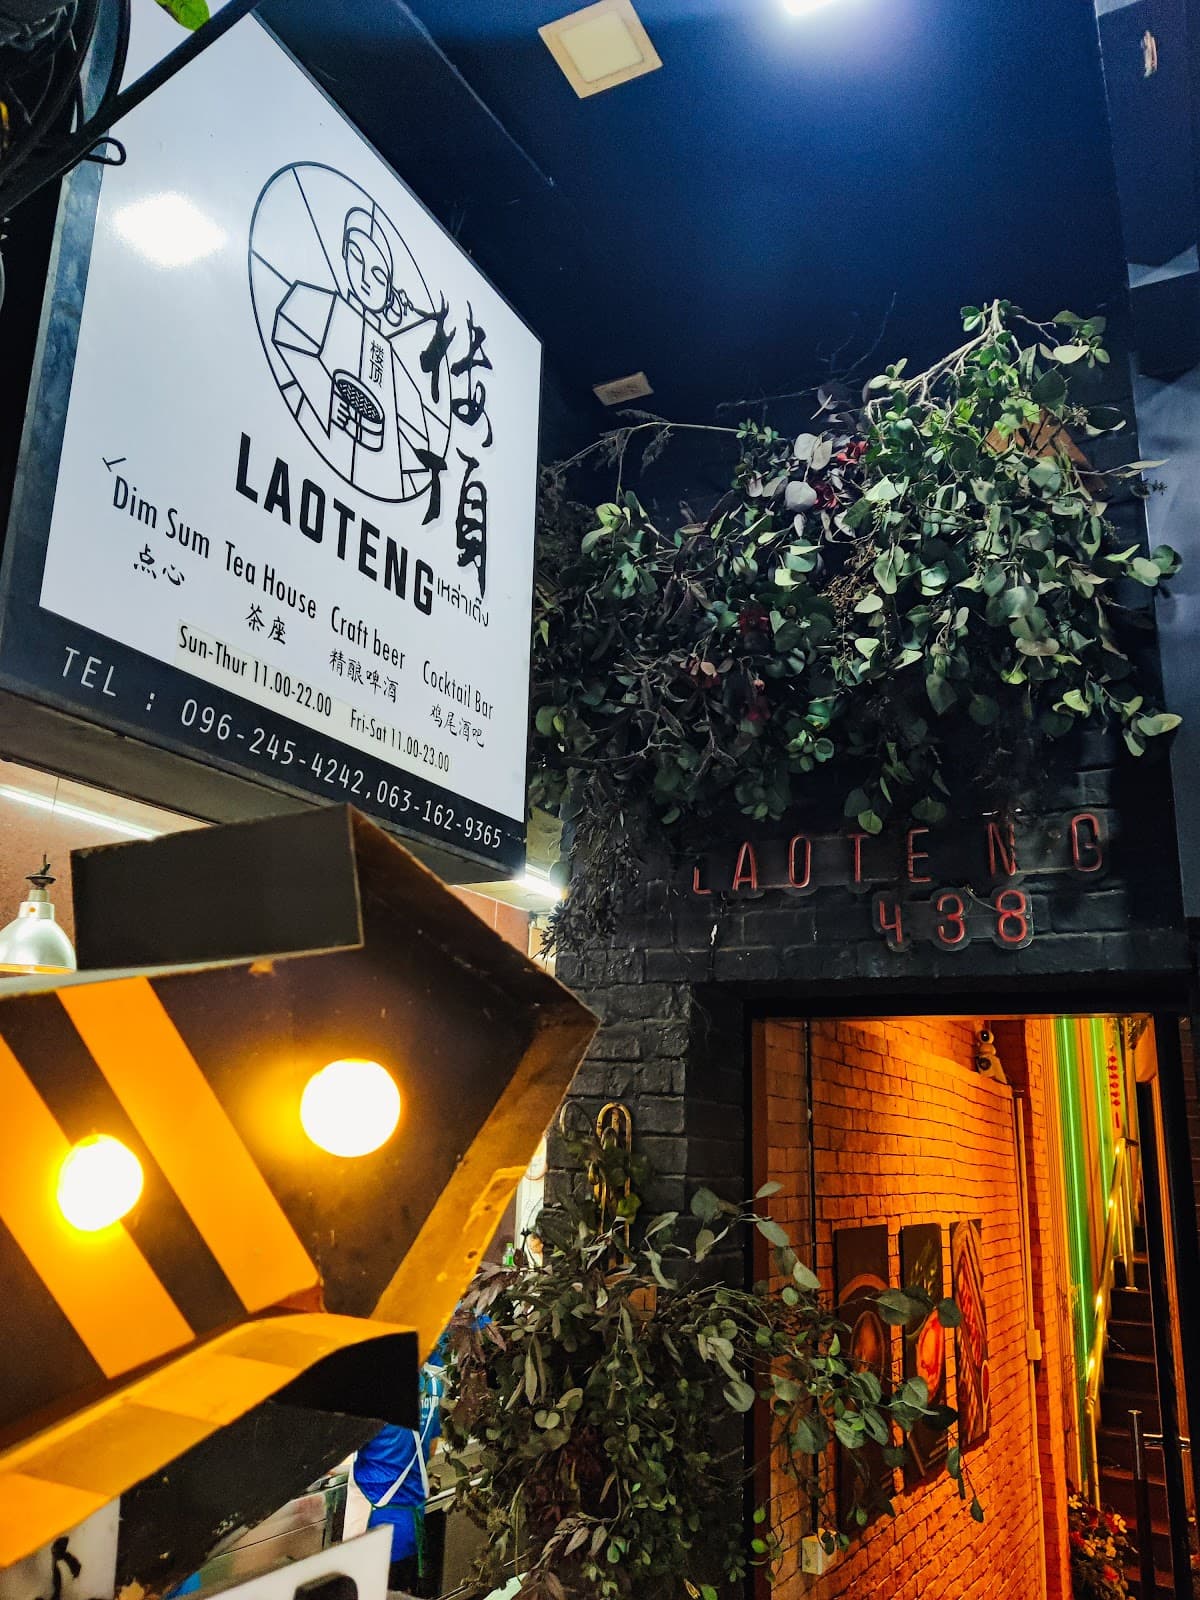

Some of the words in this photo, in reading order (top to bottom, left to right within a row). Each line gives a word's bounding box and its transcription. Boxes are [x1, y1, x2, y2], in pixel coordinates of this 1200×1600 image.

[113, 475, 157, 529] Dim
[165, 508, 210, 558] Sum
[225, 540, 256, 585] Tea
[263, 564, 317, 619] House
[331, 606, 368, 649] Craft
[373, 628, 406, 670] beer
[423, 660, 471, 708] Cocktail
[475, 690, 494, 720] Bar
[236, 432, 433, 616] LAOTENG
[62, 646, 116, 697] TEL
[133, 544, 185, 586] 点心
[245, 603, 286, 645] 茶座
[329, 648, 399, 703] 精酿啤酒
[430, 704, 485, 748] 鸡尾酒吧
[179, 625, 248, 676] Sun-Thur
[254, 660, 332, 717] 11.00-22.00
[350, 708, 387, 744] Fri-Sat
[391, 727, 450, 773] 11.00-23.00
[878, 889, 1028, 944] 438
